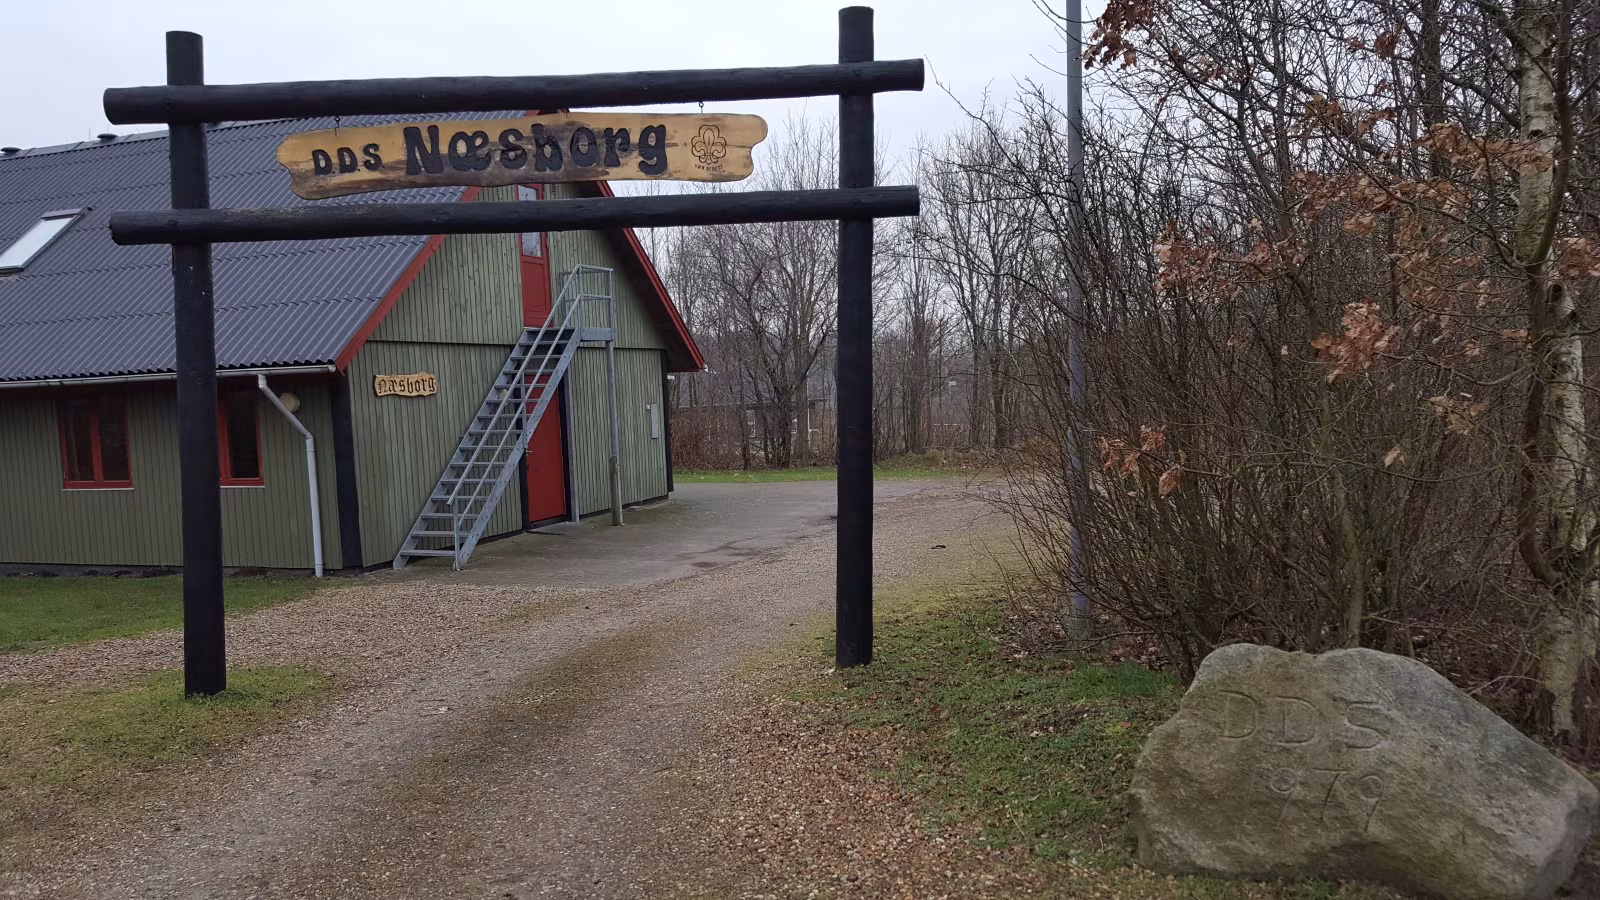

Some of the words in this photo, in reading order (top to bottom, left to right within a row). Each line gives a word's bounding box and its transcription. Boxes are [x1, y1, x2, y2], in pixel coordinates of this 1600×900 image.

[403, 123, 668, 176] Næsborg
[377, 376, 436, 394] Næsborg
[1218, 689, 1390, 750] DDS
